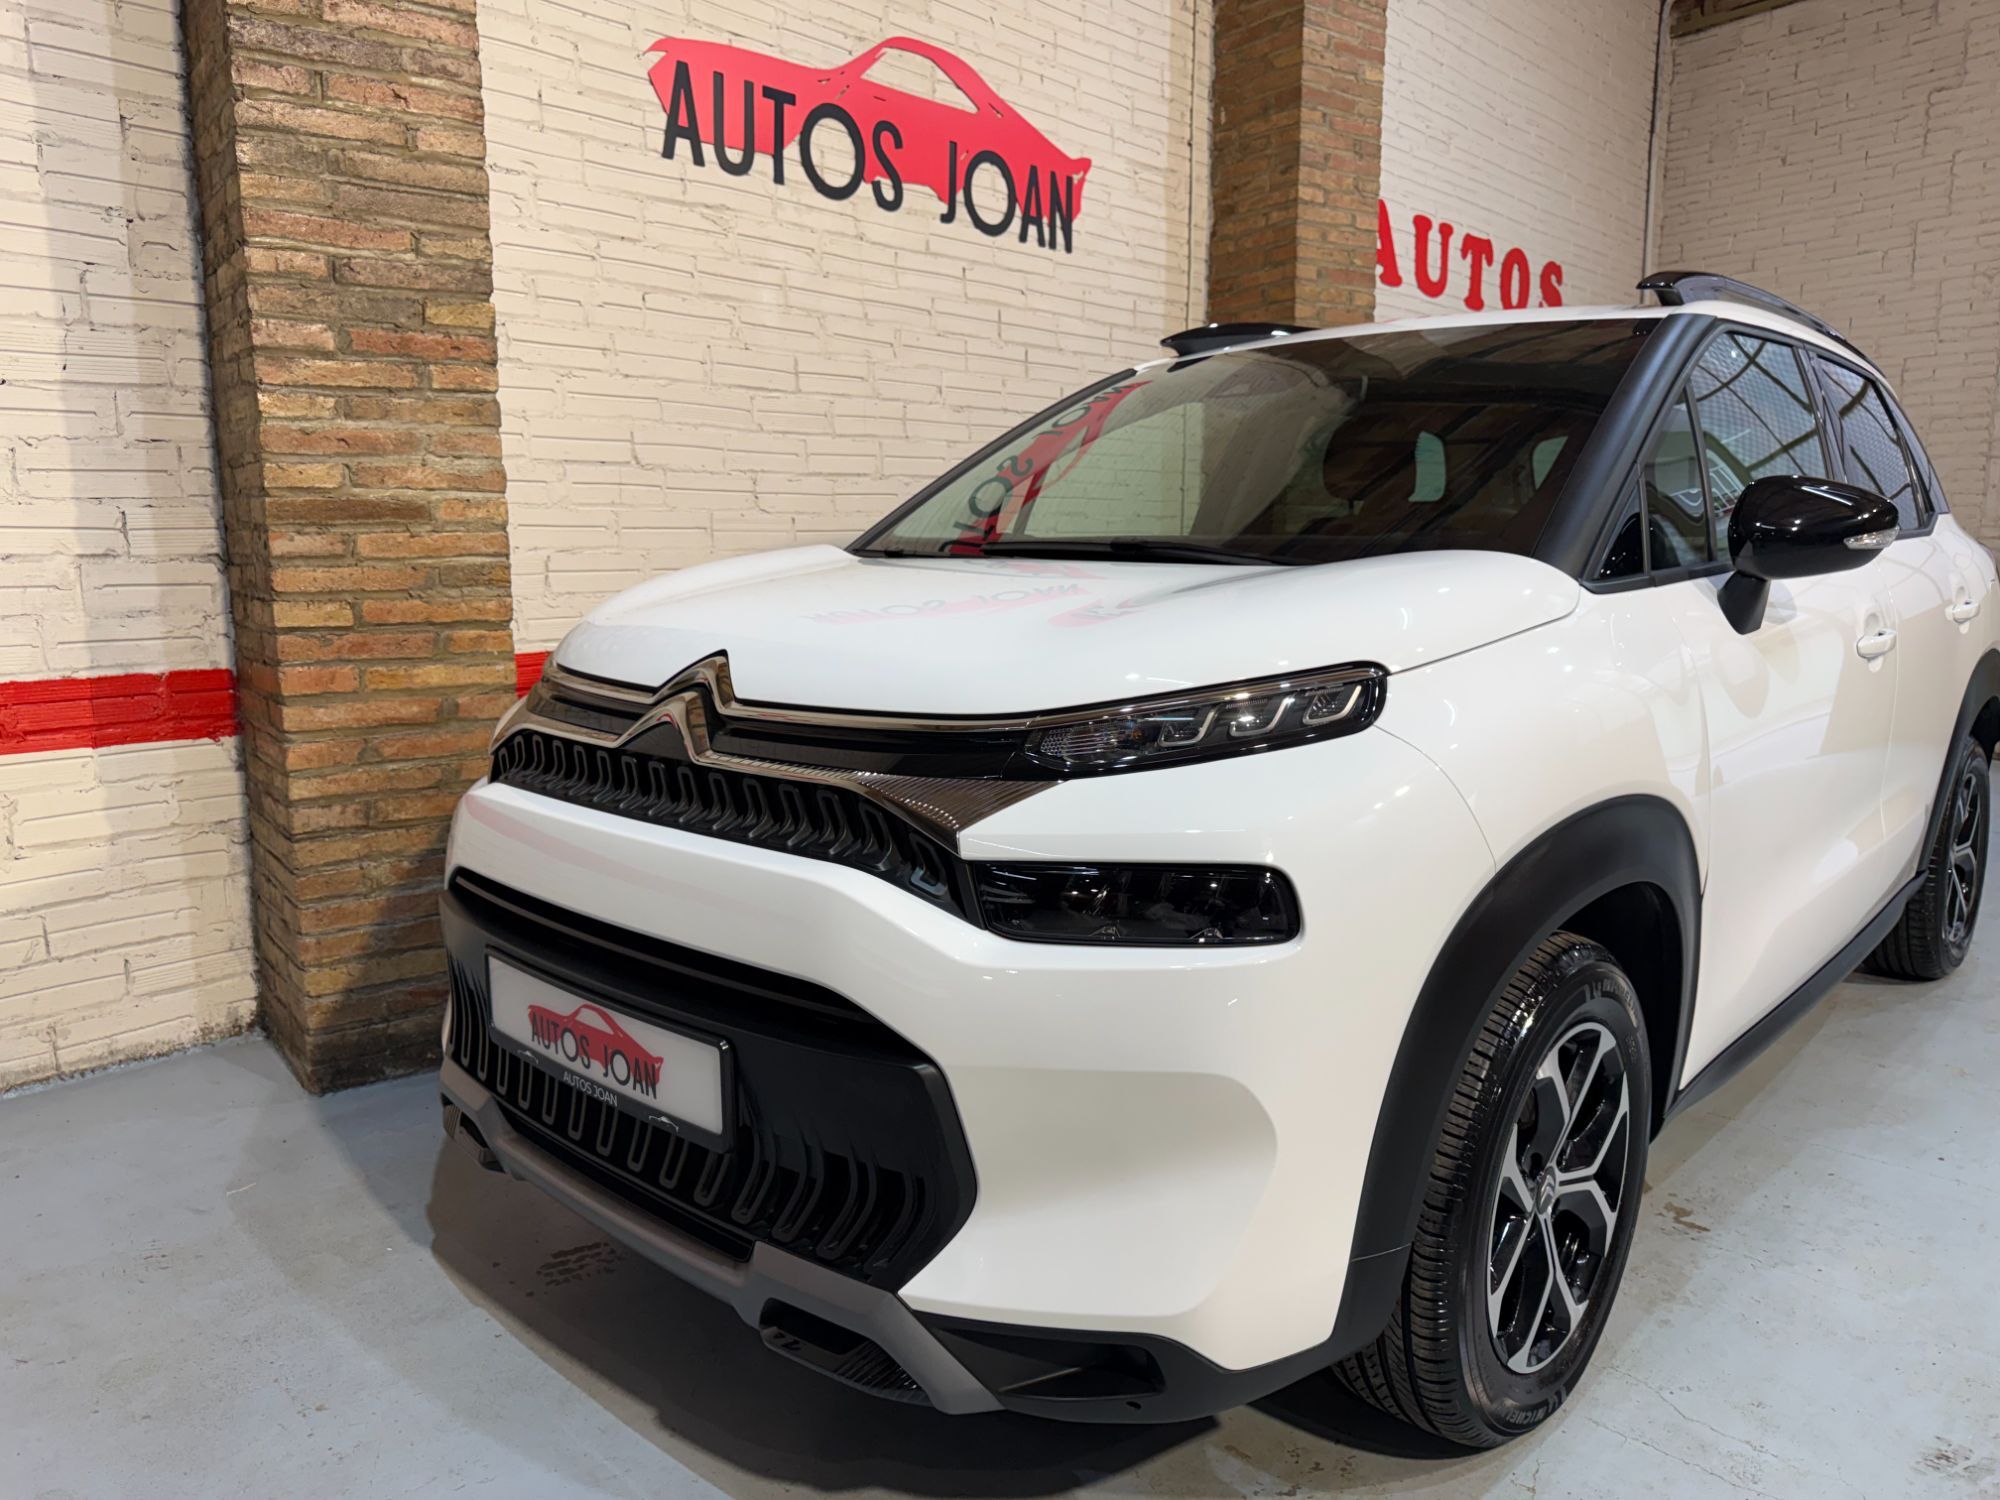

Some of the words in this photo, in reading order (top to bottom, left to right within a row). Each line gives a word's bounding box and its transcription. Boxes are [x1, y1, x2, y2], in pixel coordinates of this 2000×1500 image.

[662, 60, 903, 212] AUTOS
[940, 140, 1074, 254] JOAN
[531, 1011, 591, 1069] AUTOS
[603, 1045, 657, 1099] JOAN
[563, 1071, 592, 1094] AUTOS
[593, 1085, 618, 1107] JOAN
